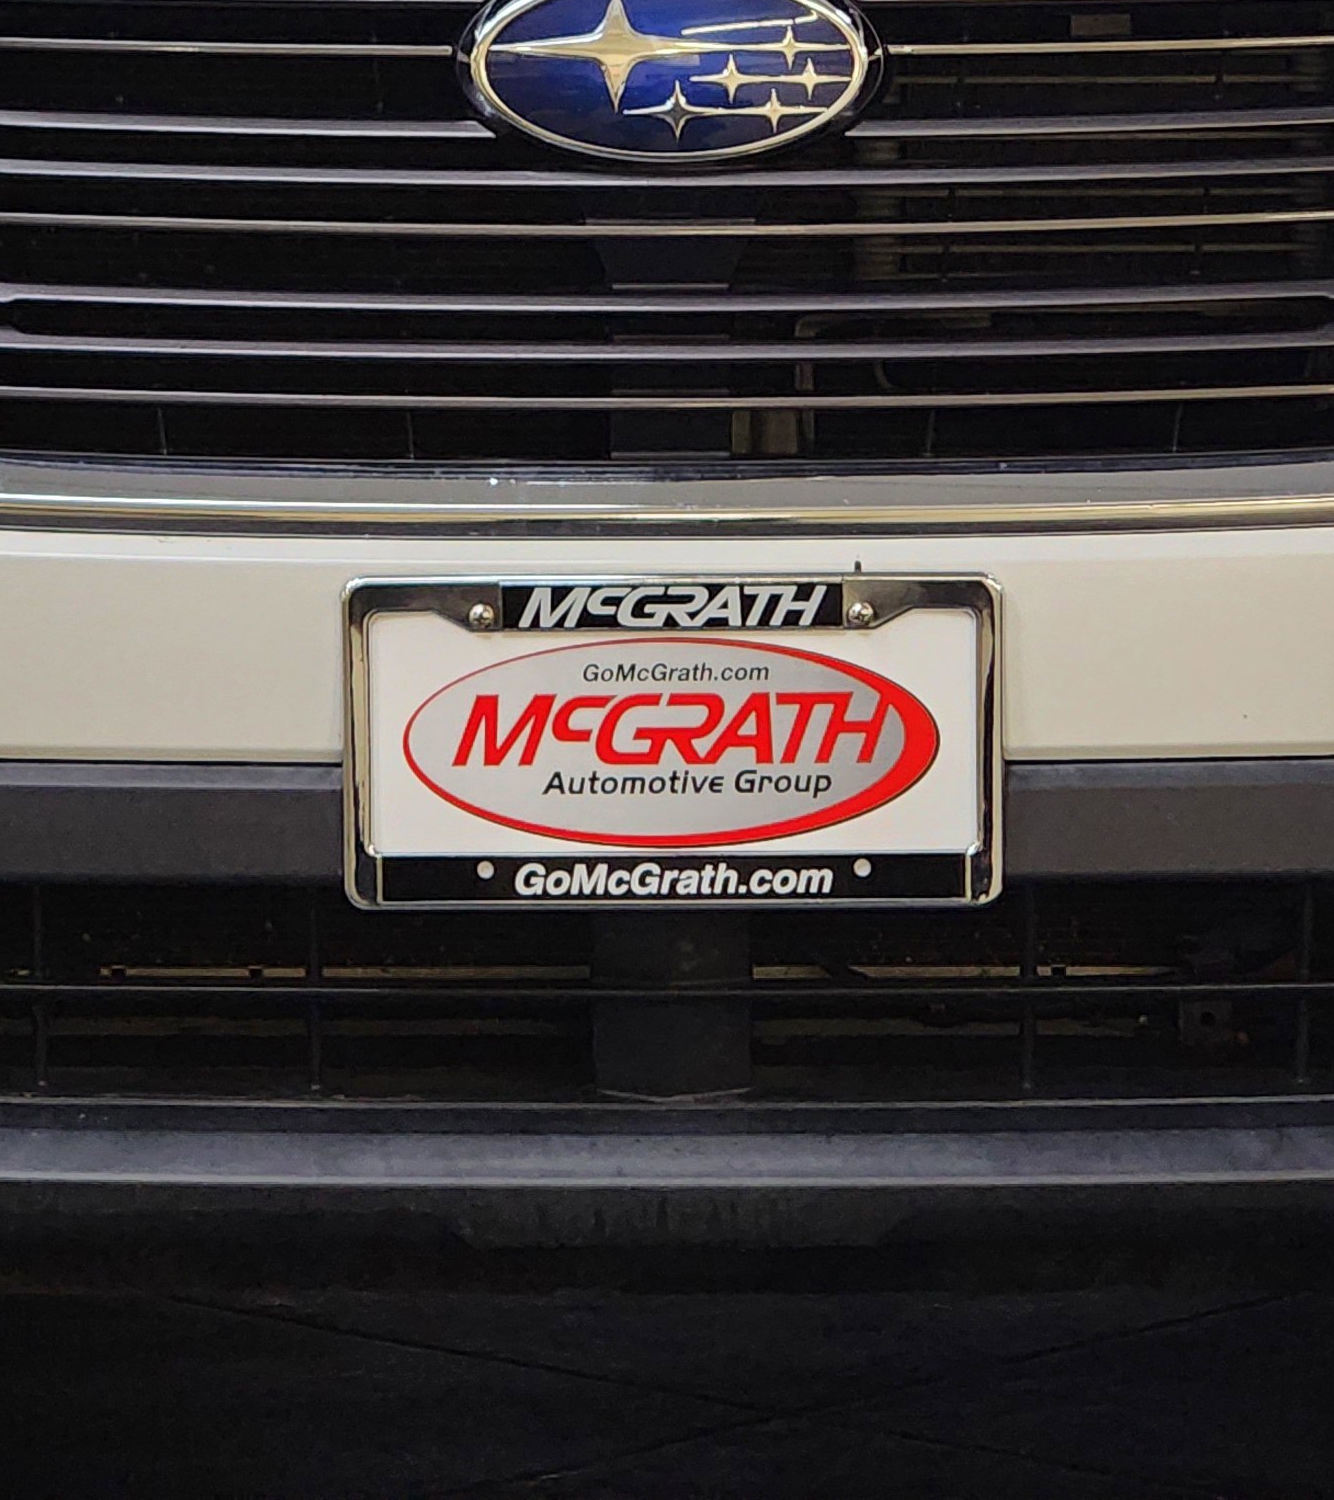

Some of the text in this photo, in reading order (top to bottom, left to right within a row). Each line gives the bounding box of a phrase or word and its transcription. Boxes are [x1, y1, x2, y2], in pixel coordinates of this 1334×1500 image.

[582, 662, 770, 683] GoMcGrath.com
[541, 769, 833, 799] Automotive Group
[514, 861, 834, 897] GoMcGrath.com
